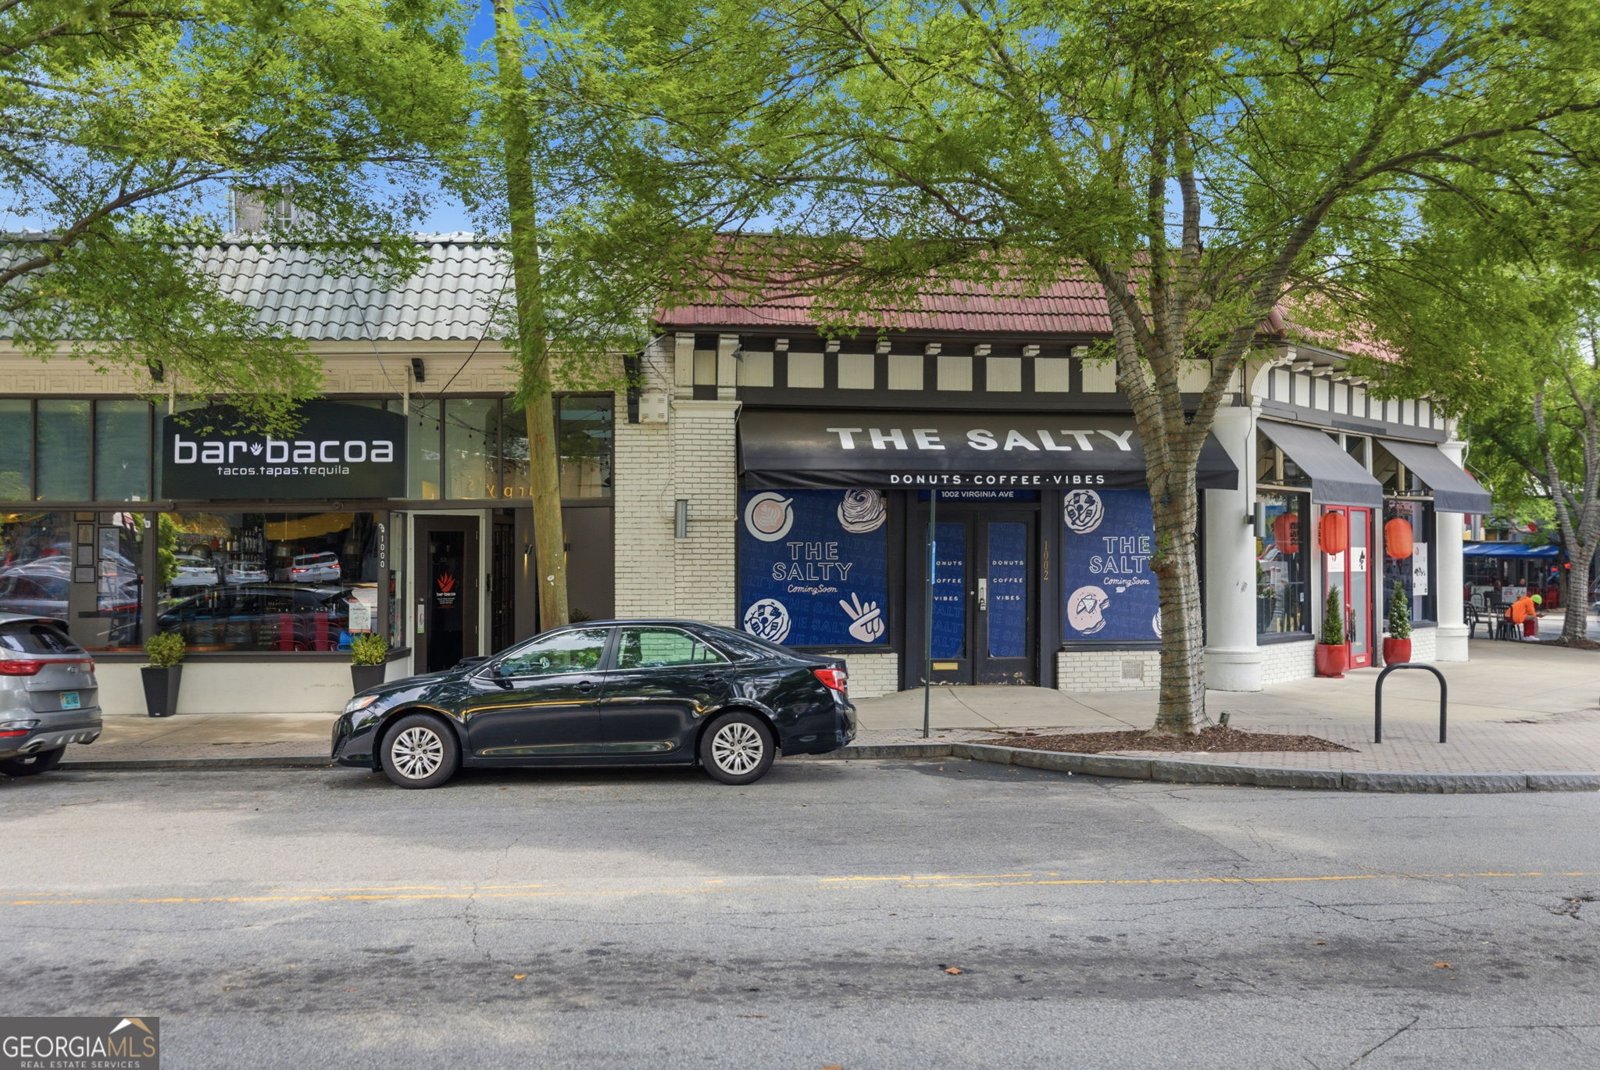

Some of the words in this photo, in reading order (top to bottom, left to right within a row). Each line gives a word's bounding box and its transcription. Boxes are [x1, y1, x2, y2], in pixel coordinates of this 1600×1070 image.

[174, 433, 248, 464] bar
[266, 434, 394, 463] bacoa
[826, 428, 946, 450] THE
[966, 429, 1134, 451] SALTY
[217, 465, 350, 478] tacos.tapas.tequila
[890, 474, 962, 485] DONUTS
[973, 475, 1042, 485] COFFEE
[1053, 475, 1105, 485] VIBES
[786, 541, 839, 561] THE
[1102, 536, 1151, 554] THE
[772, 562, 853, 581] SALTY
[1089, 555, 1154, 574] SALT
[787, 584, 818, 595] Coming
[818, 584, 838, 593] Soon
